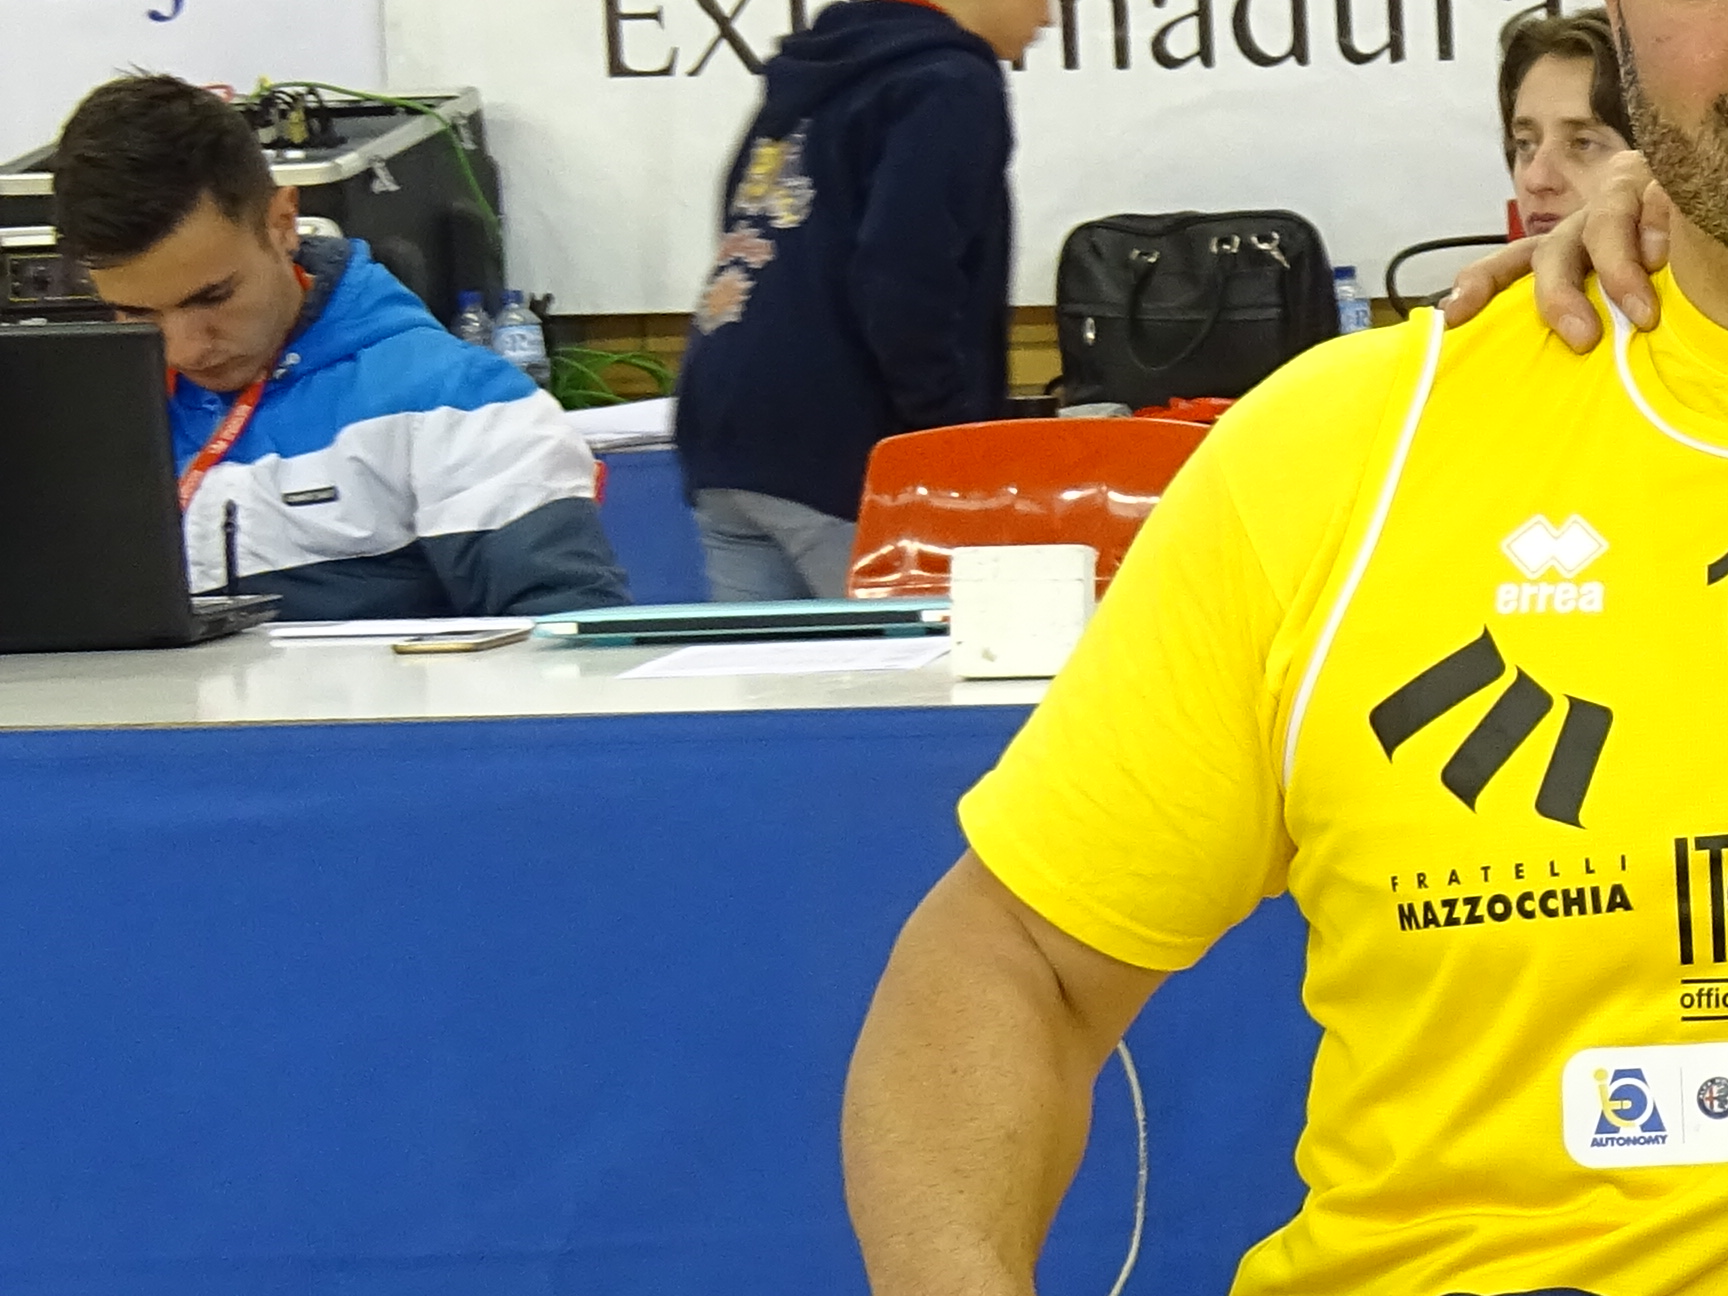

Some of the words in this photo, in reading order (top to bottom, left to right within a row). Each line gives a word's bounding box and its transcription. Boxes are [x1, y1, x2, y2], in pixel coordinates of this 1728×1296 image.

[1391, 855, 1626, 892] FRATELLI
[1397, 884, 1634, 931] MAZZOCCHIA
[1590, 1134, 1668, 1148] AUTONOMY
